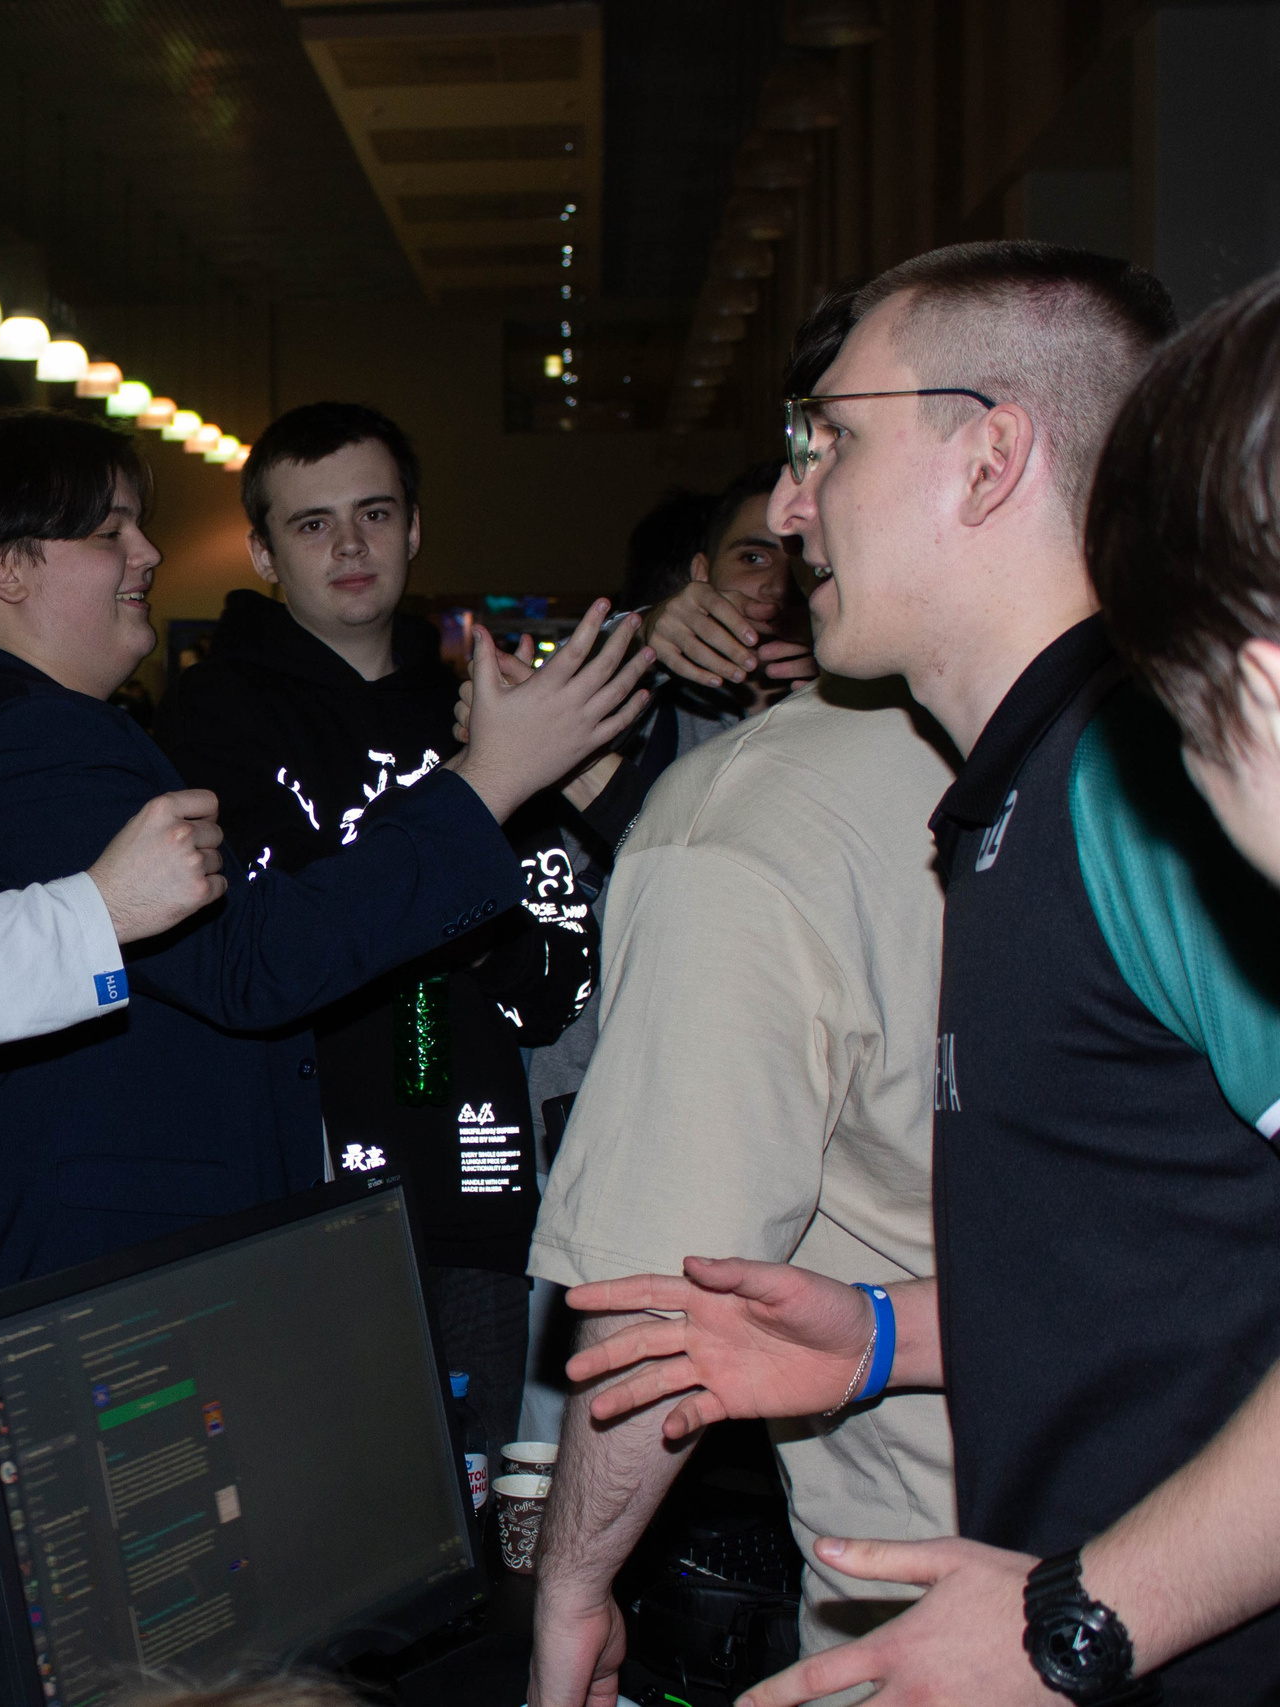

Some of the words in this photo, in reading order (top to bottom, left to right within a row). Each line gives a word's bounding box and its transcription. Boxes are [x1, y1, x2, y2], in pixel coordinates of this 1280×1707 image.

[561, 903, 588, 919] WHO
[488, 1135, 506, 1143] HAND
[514, 1500, 536, 1513] Coffee
[508, 1523, 520, 1532] Tea
